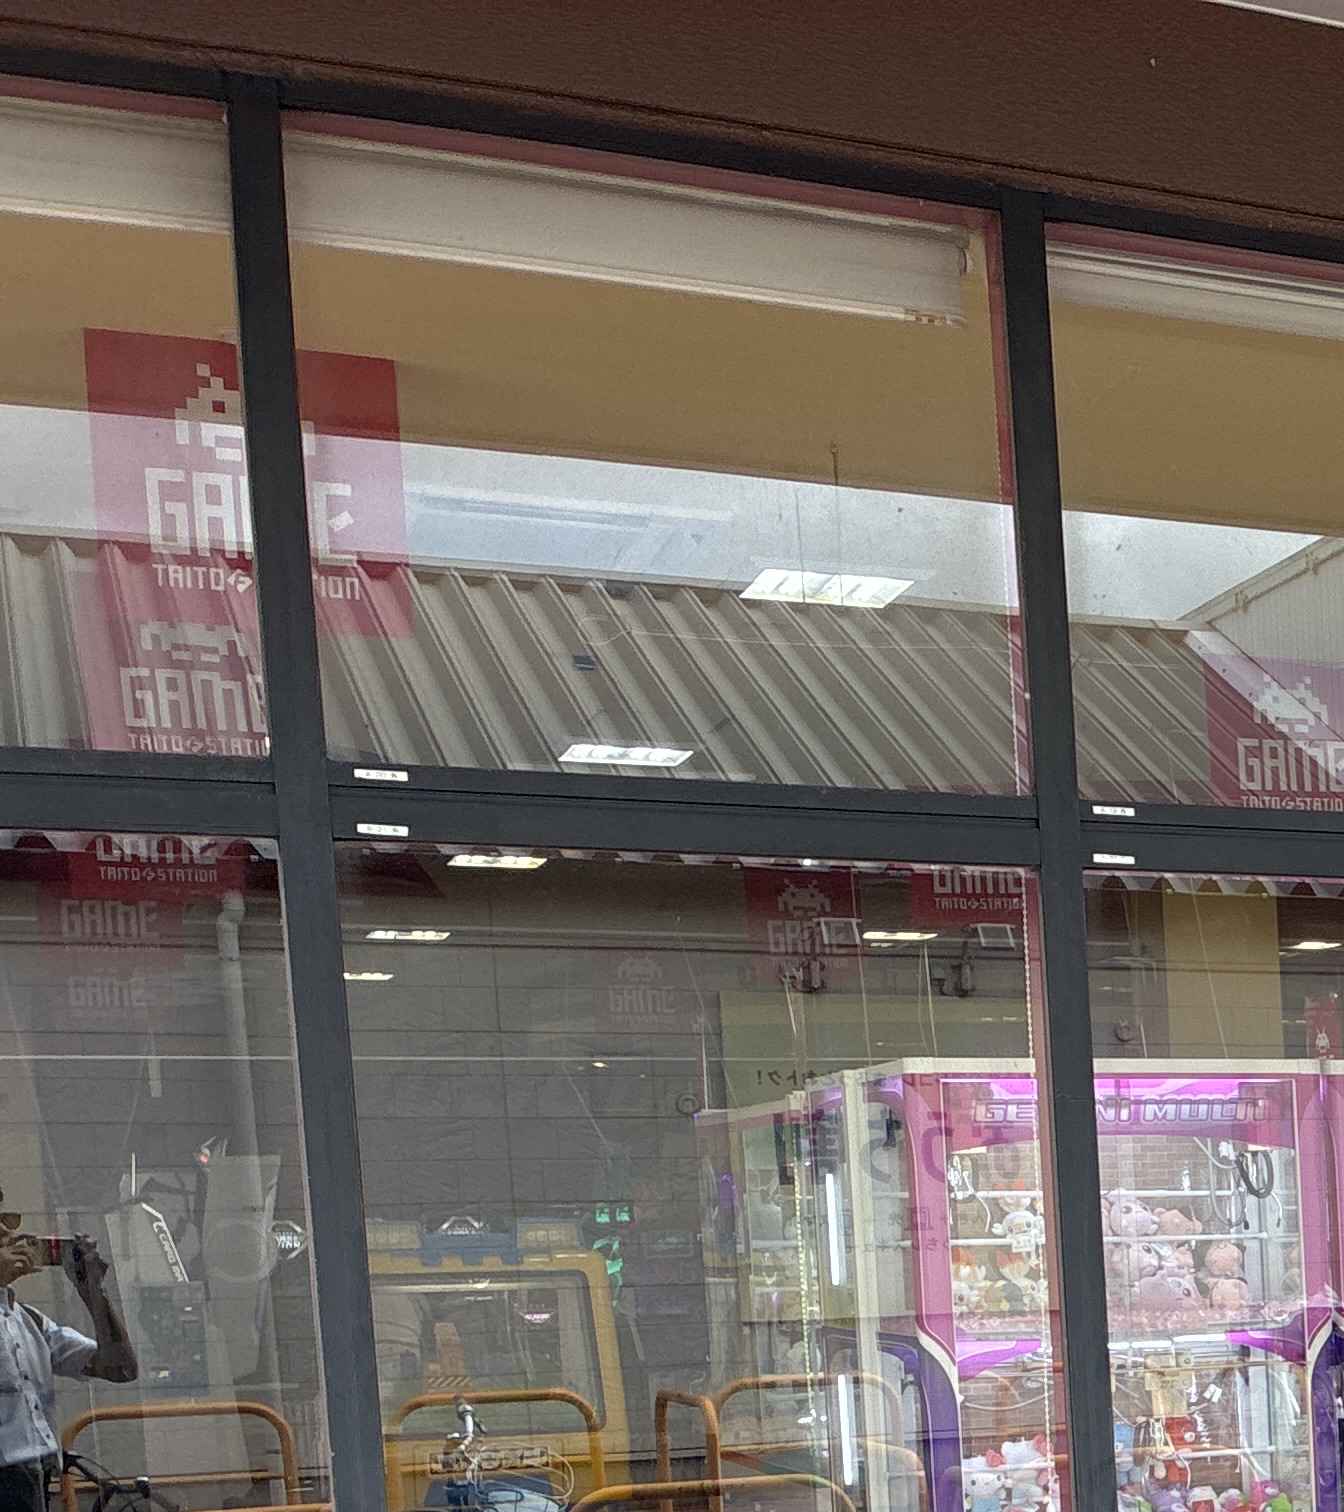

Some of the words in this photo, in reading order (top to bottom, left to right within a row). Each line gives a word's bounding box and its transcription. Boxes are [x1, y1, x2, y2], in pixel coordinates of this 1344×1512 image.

[145, 467, 357, 567] GAE
[153, 563, 225, 592] TAITO
[204, 734, 269, 757] STATIO
[100, 867, 141, 882] TAITO
[158, 869, 217, 883] STATION
[935, 898, 967, 910] TAITO
[61, 899, 160, 940] GAME
[68, 975, 148, 1008] GAME
